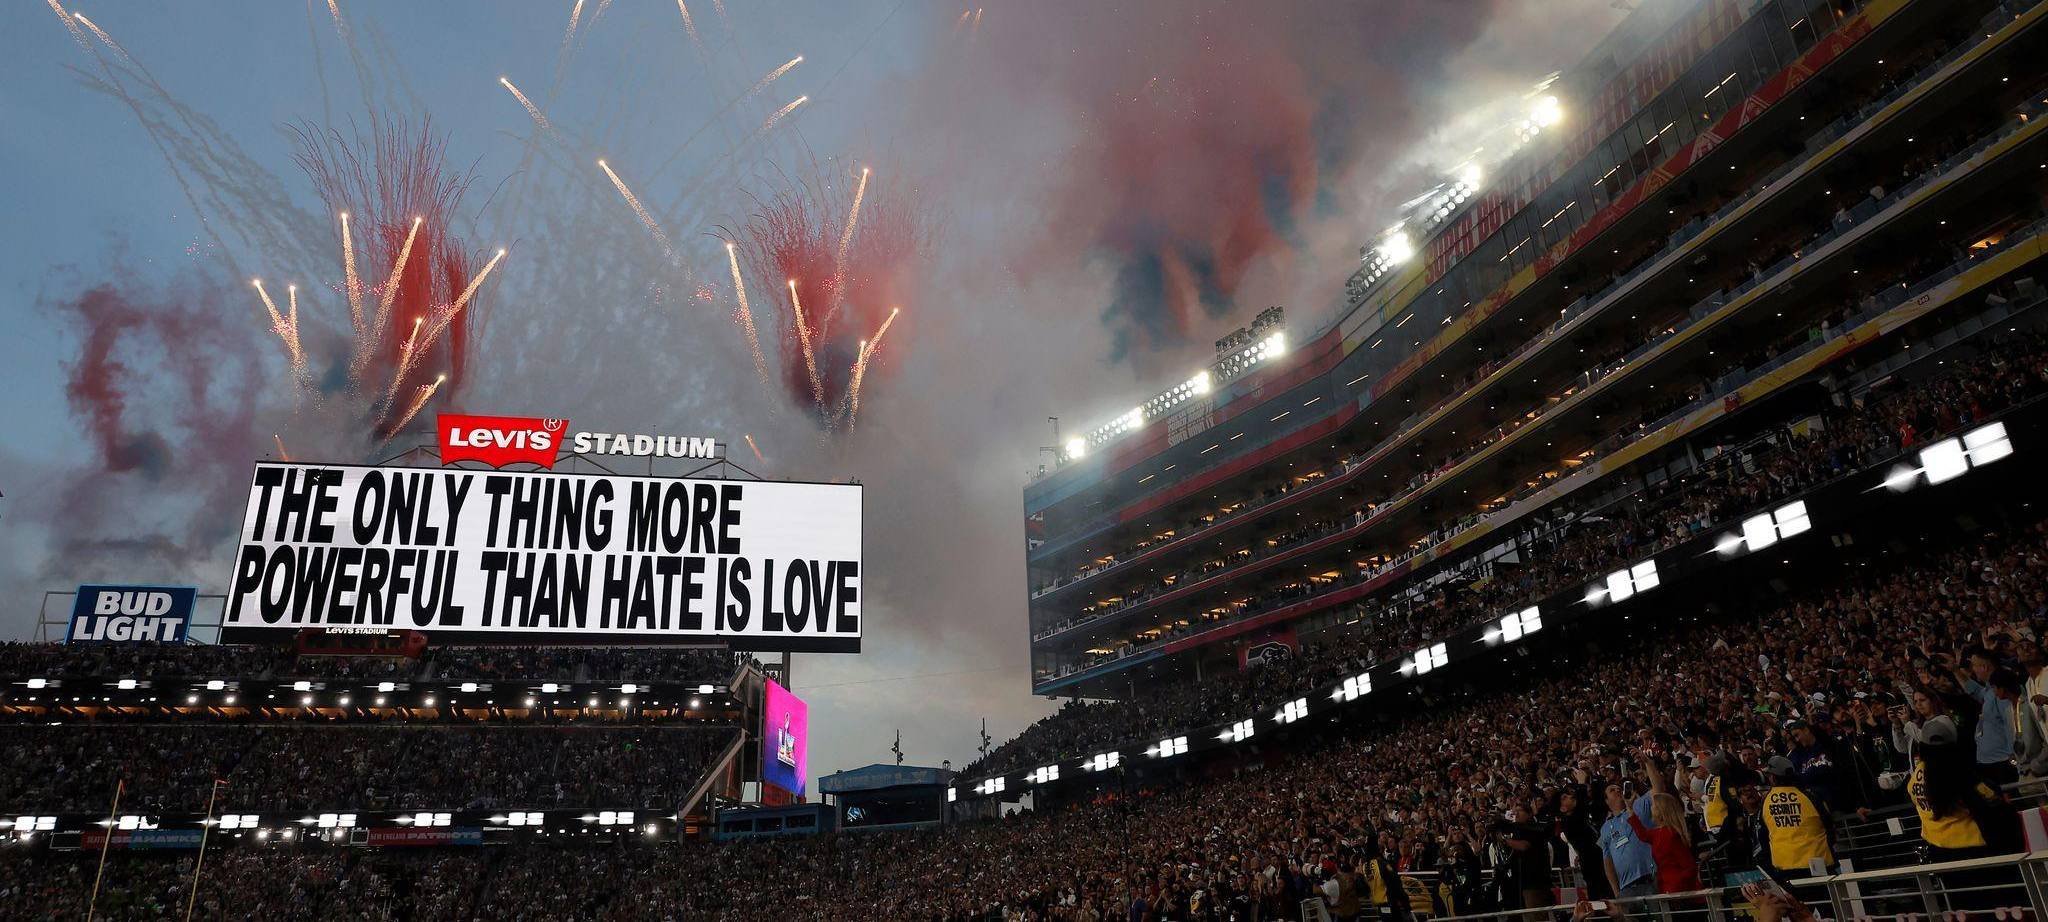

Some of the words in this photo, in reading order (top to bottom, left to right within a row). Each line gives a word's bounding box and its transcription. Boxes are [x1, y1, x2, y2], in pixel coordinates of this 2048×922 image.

[573, 431, 715, 459] STADIUM
[252, 467, 345, 543] THE
[352, 470, 474, 546] ONLY
[485, 476, 614, 551] THING
[625, 481, 743, 554] MORE
[228, 544, 465, 627] POWERFUL
[480, 551, 592, 628] THAN
[599, 550, 706, 630] HATE
[714, 556, 753, 632] IS
[761, 557, 859, 633] LOVE
[95, 591, 173, 616] BUD
[73, 616, 183, 641] LIGHT
[1769, 803, 1801, 815] SECURITY
[1771, 792, 1798, 803] CSC
[1774, 815, 1802, 827] STAFF
[407, 831, 481, 840] PATRIOTS
